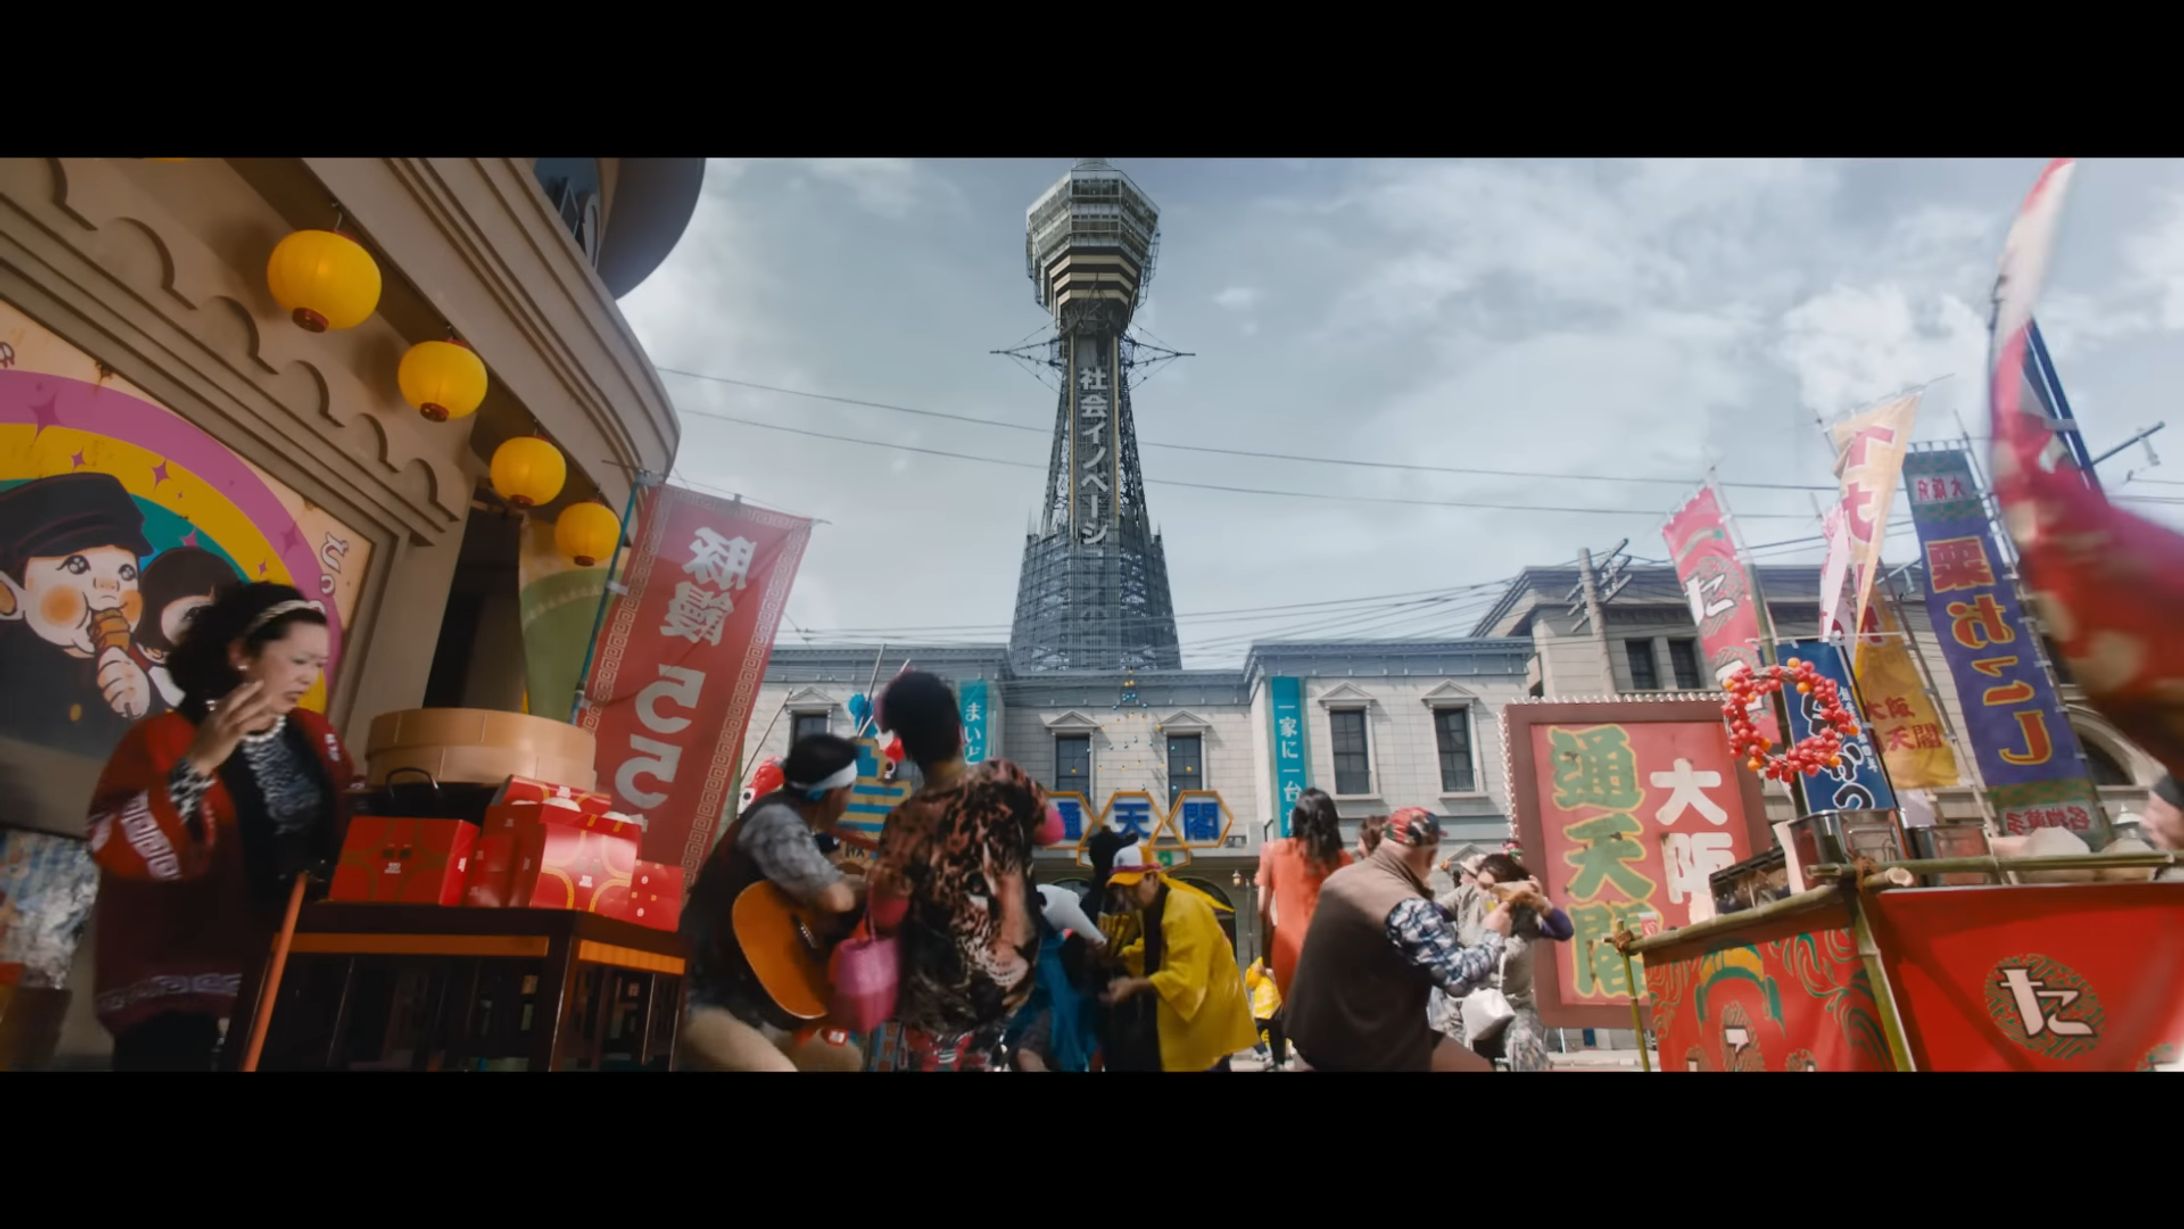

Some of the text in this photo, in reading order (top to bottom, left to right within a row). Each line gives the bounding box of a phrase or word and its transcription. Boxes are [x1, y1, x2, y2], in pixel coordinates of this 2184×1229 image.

[964, 702, 982, 765] まいど
[1870, 723, 1942, 752] 天閣
